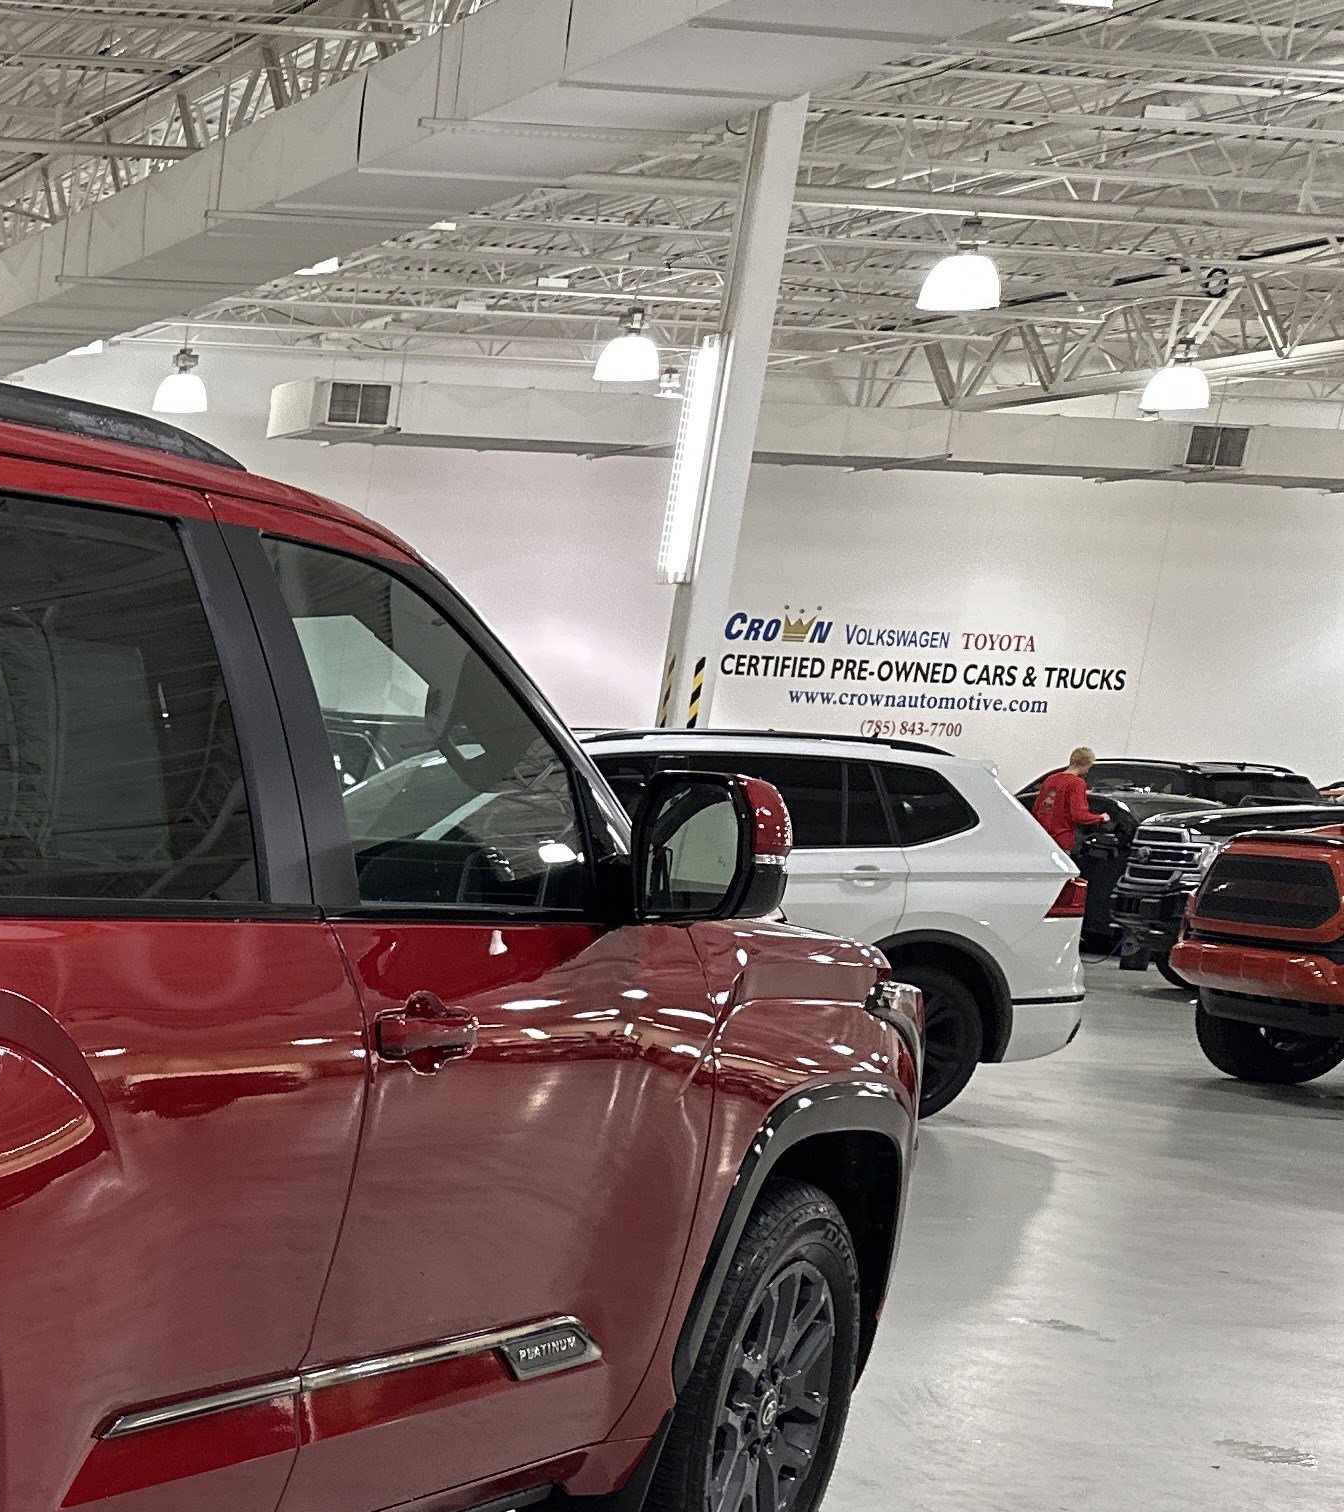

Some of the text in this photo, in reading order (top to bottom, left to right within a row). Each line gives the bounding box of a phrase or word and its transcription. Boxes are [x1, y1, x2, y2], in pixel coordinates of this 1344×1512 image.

[845, 624, 950, 649] VOLKSWAGEN
[961, 632, 1036, 653] TOYOTA
[720, 653, 1127, 691] CERTIFIED PRE-OWNED CARS & TRUCKS
[788, 688, 1049, 714] www.crownautomotive.com
[860, 719, 963, 738] (785) 843-7700
[518, 1336, 576, 1363] PLATINUM
